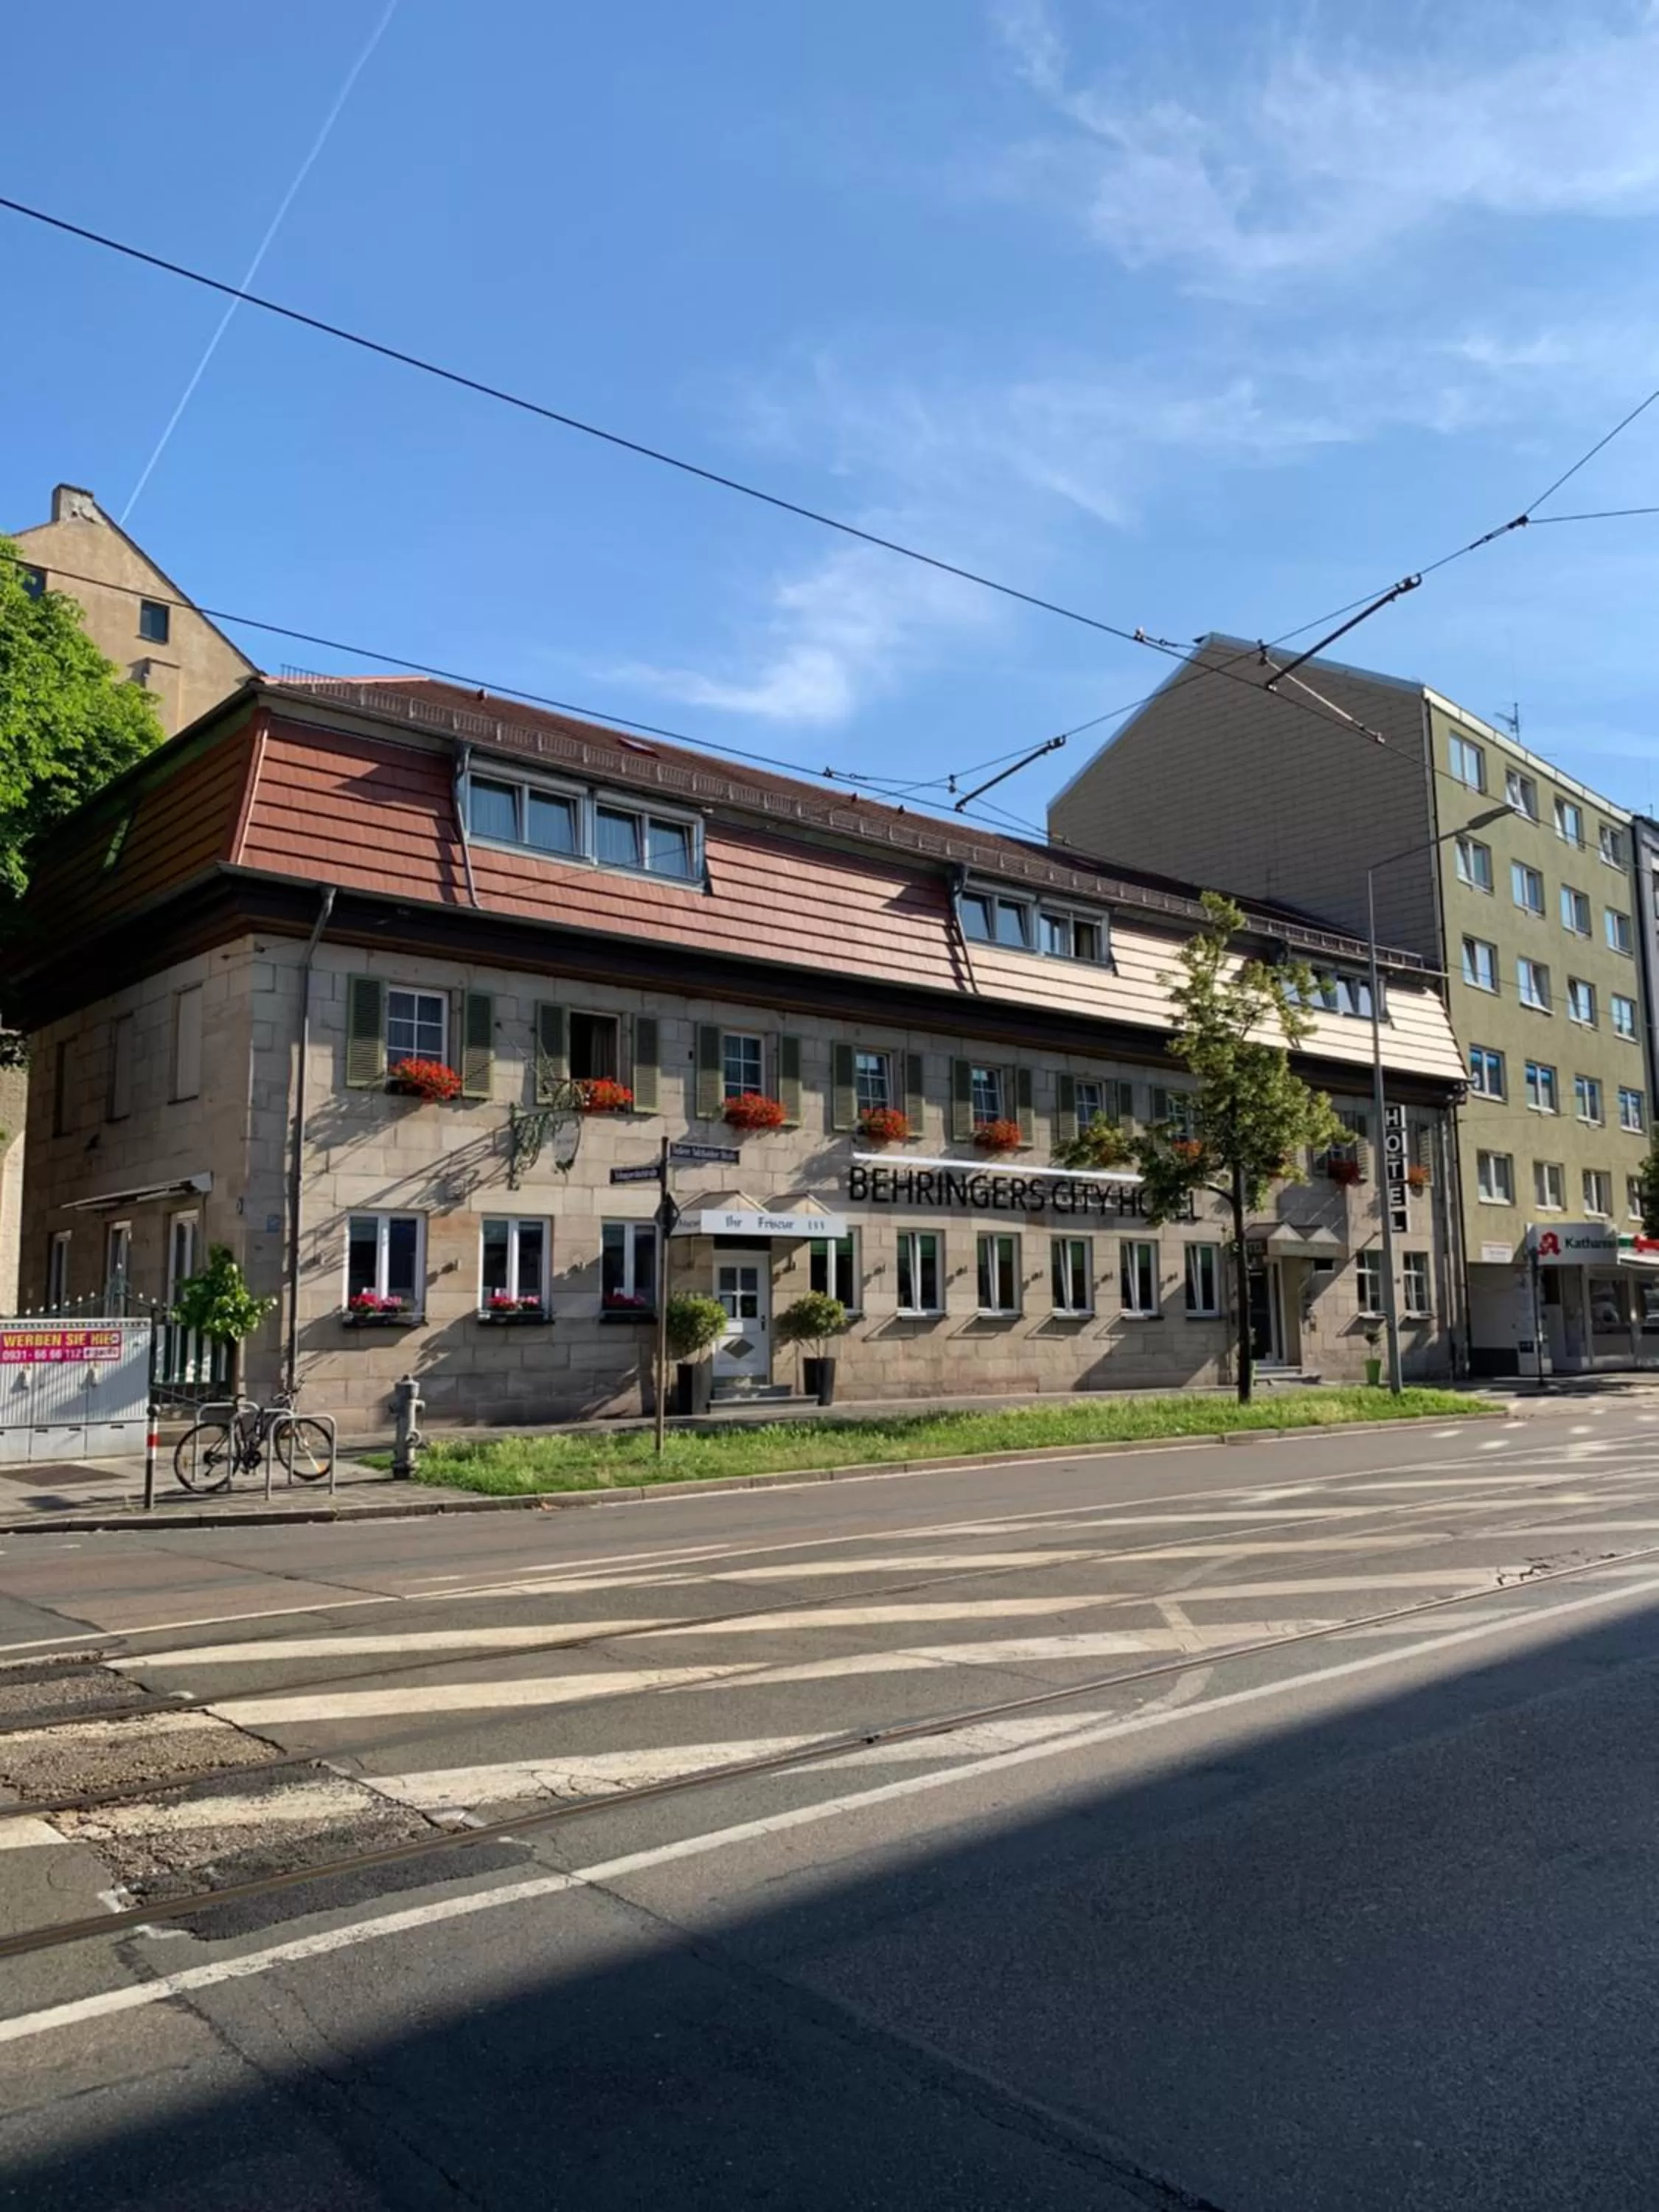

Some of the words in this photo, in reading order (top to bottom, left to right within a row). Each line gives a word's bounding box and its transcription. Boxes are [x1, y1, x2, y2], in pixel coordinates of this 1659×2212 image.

[849, 1166, 1045, 1211] BEHRINGERS
[1051, 1181, 1111, 1215] CITY
[1119, 1185, 1203, 1220] HOL
[1385, 1108, 1404, 1231] HOTEL
[3, 1333, 62, 1347] WERBEN
[66, 1332, 86, 1346] SIE
